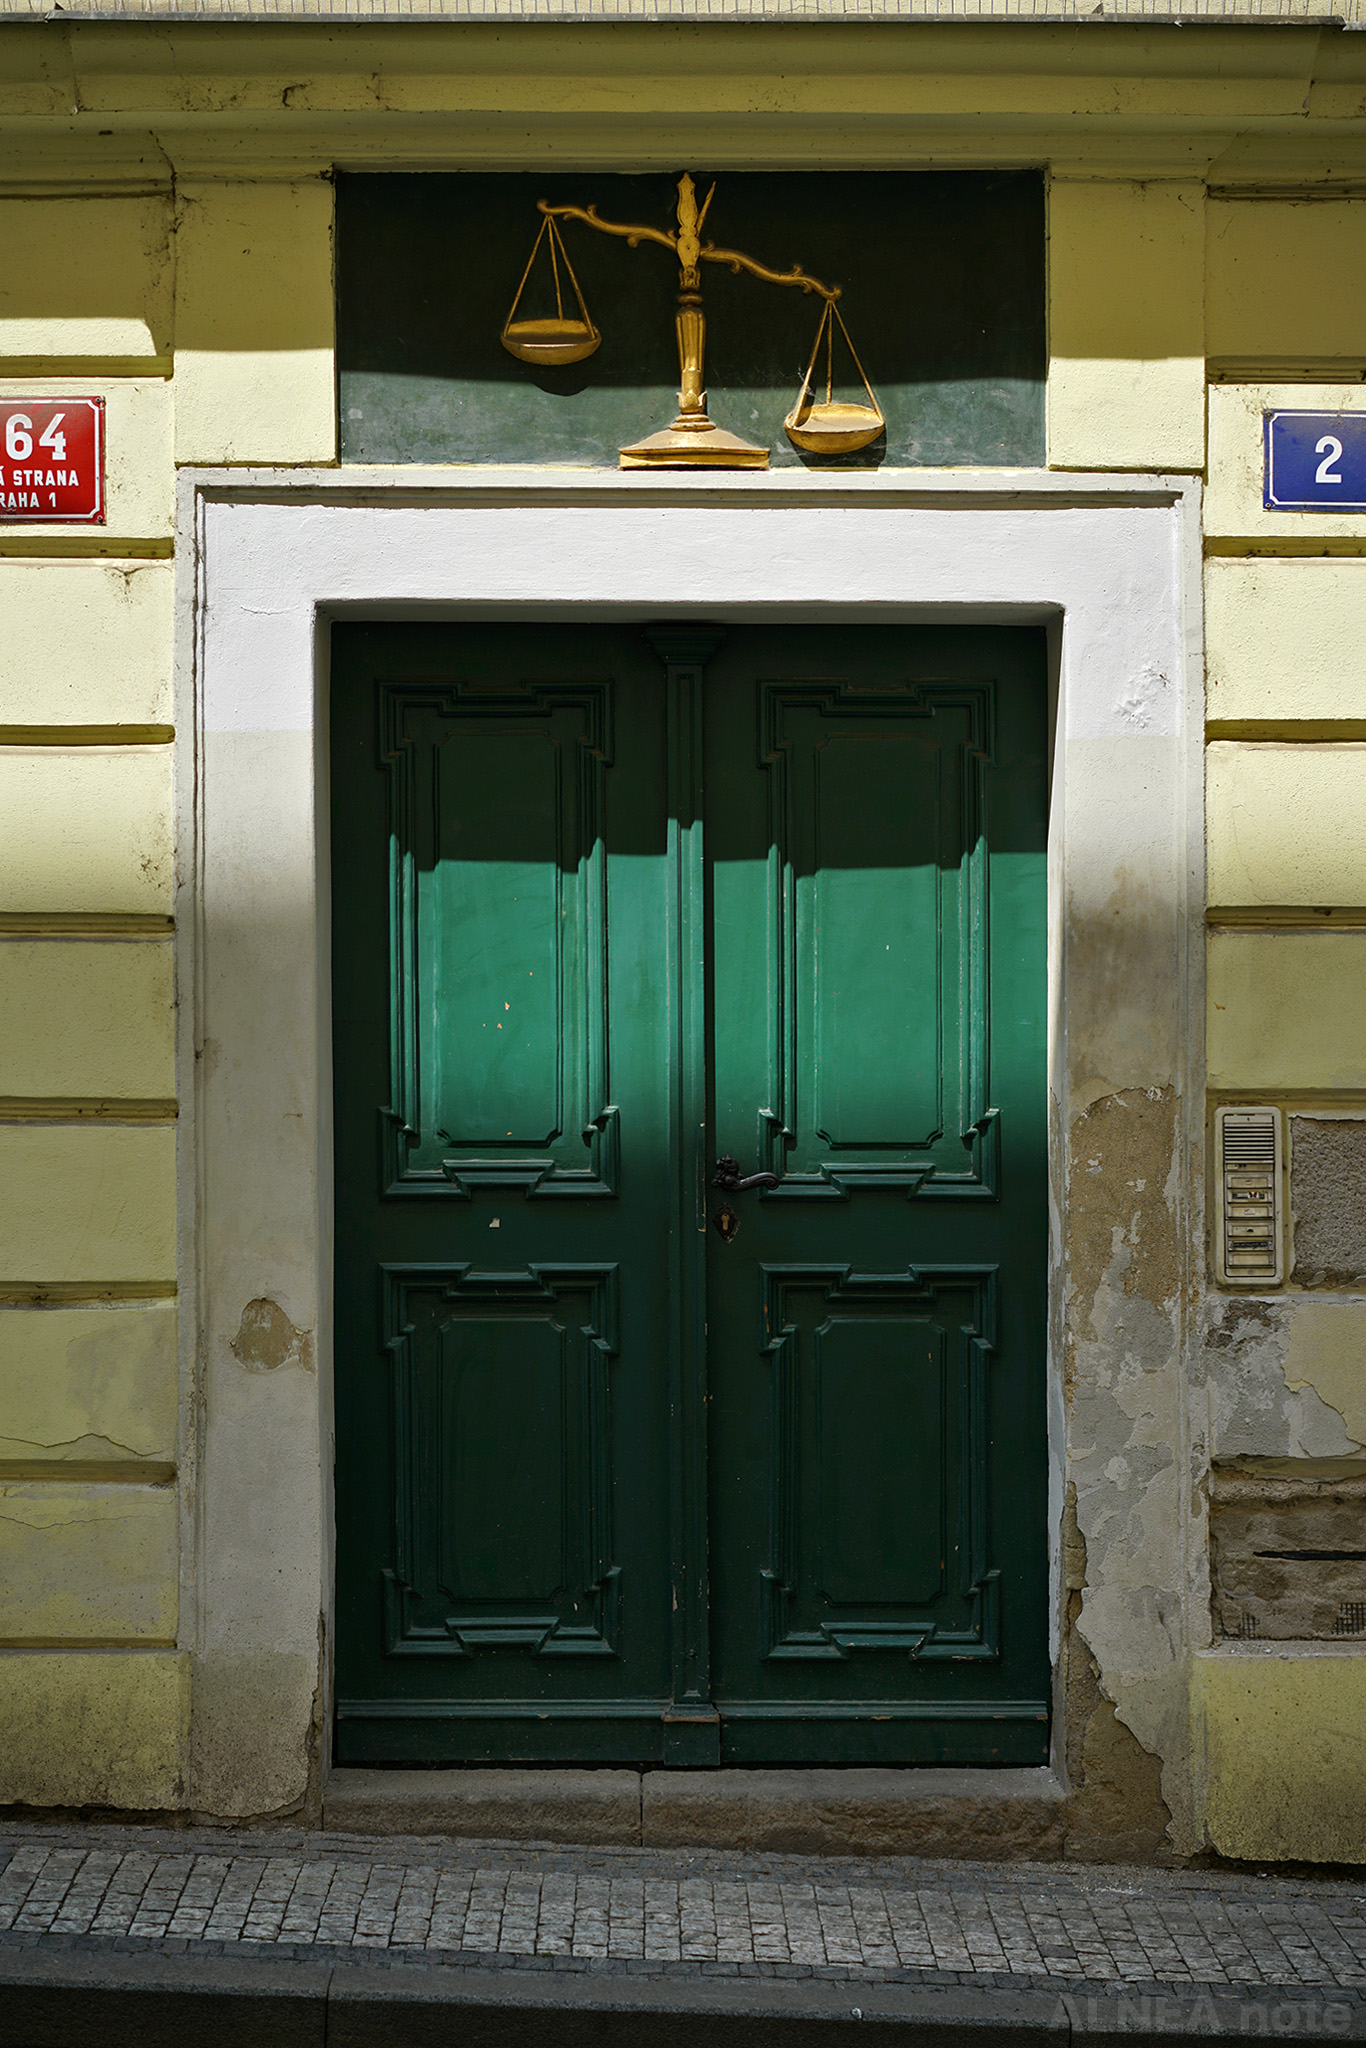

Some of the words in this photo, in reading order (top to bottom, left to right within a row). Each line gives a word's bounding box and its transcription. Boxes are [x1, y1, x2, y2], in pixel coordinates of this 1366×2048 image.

[6, 413, 66, 461] 64
[1315, 435, 1343, 484] 2
[13, 470, 79, 487] STRANA
[49, 492, 56, 508] 1
